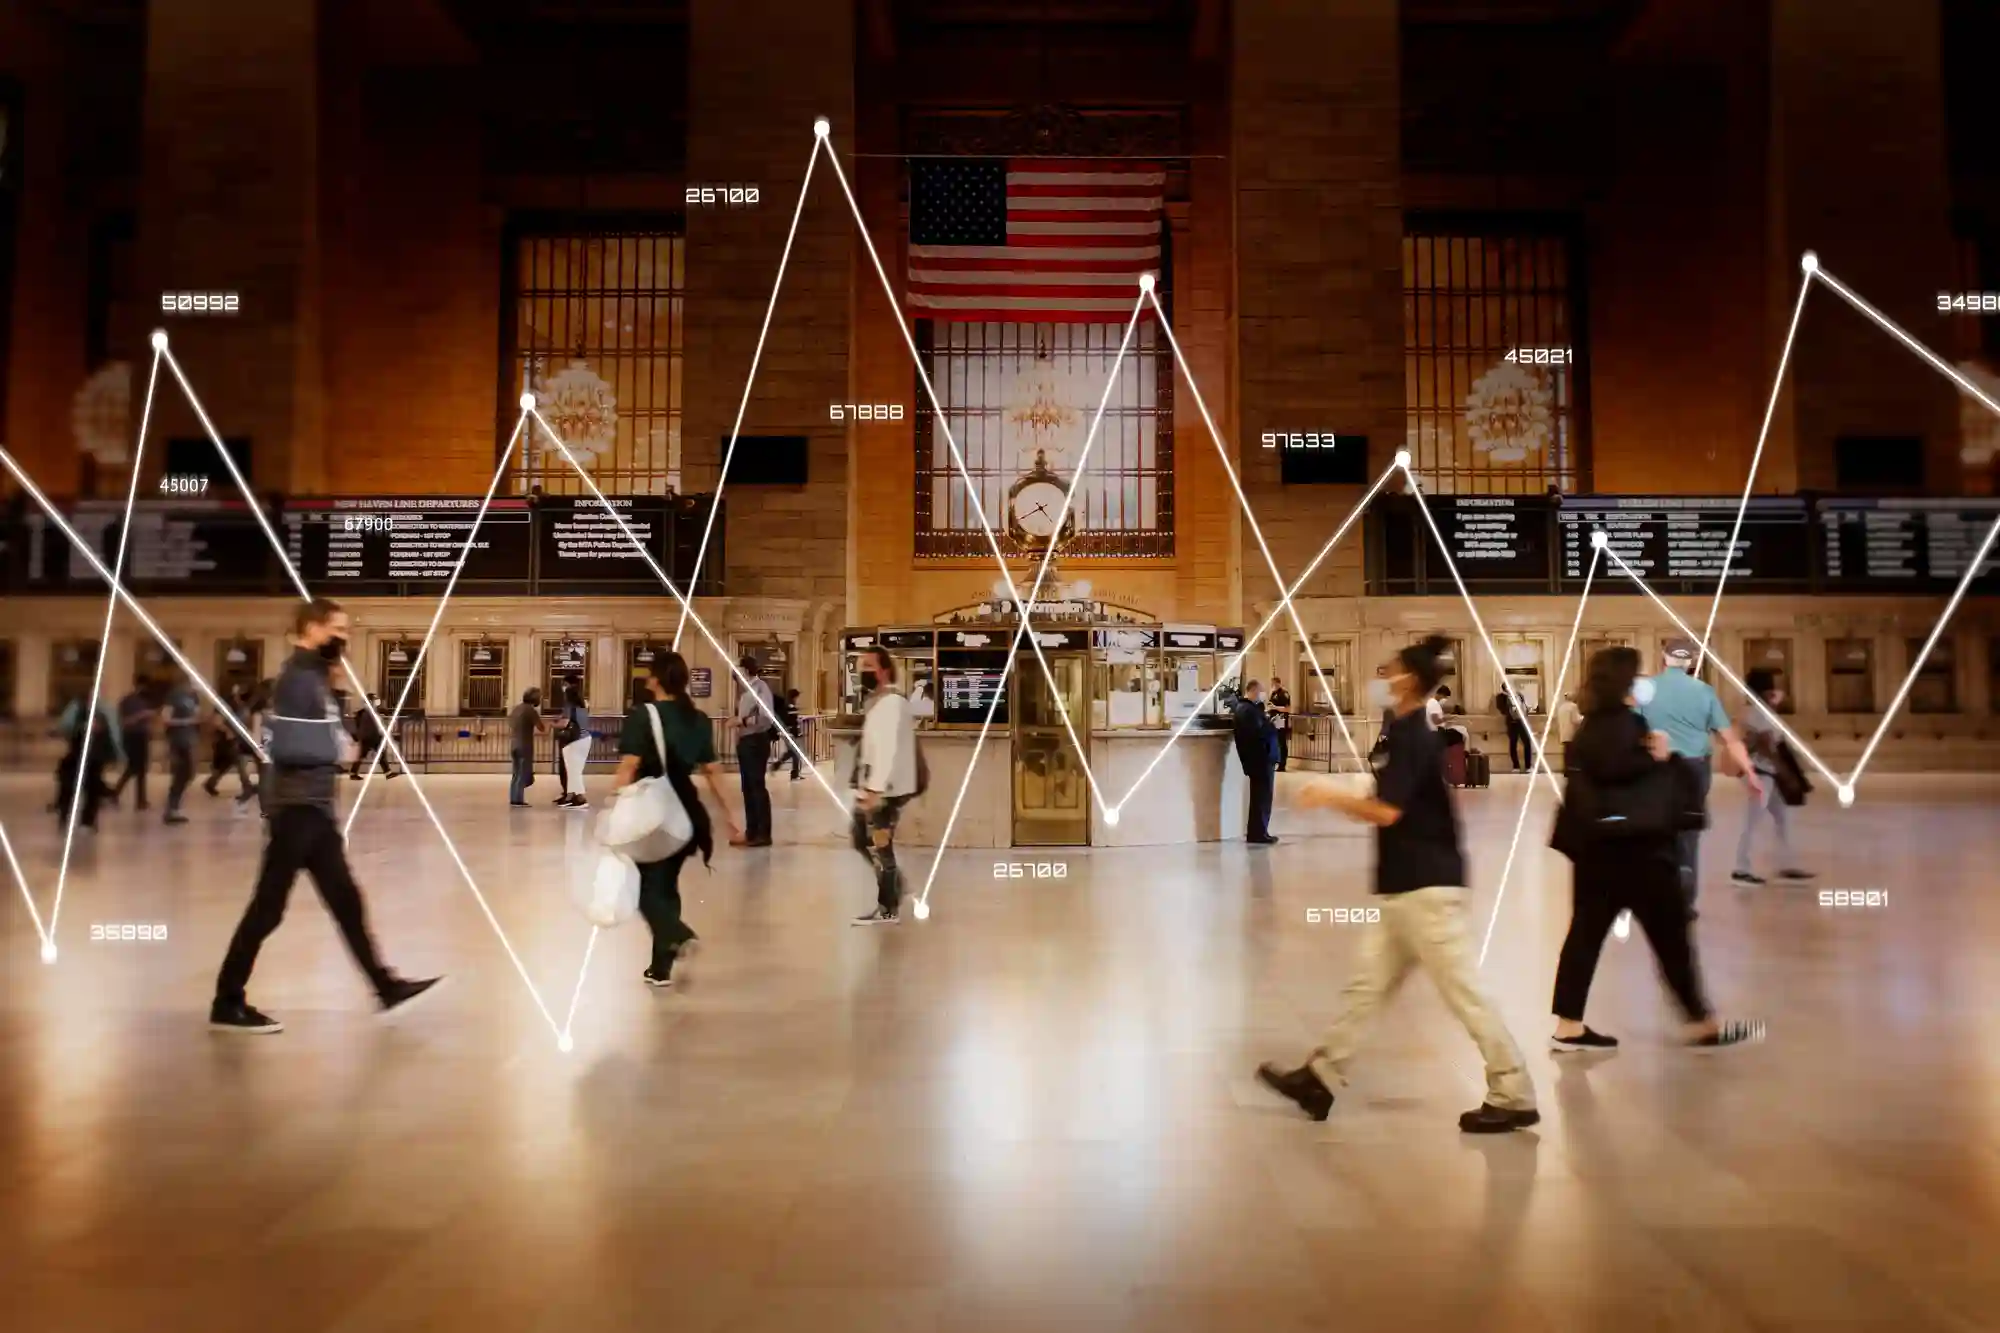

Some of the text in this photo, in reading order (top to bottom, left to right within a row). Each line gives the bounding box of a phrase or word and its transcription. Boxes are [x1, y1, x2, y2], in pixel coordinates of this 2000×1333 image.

[359, 500, 393, 508] HAVEN
[394, 500, 417, 508] LINE
[418, 500, 480, 508] DEPARTURES
